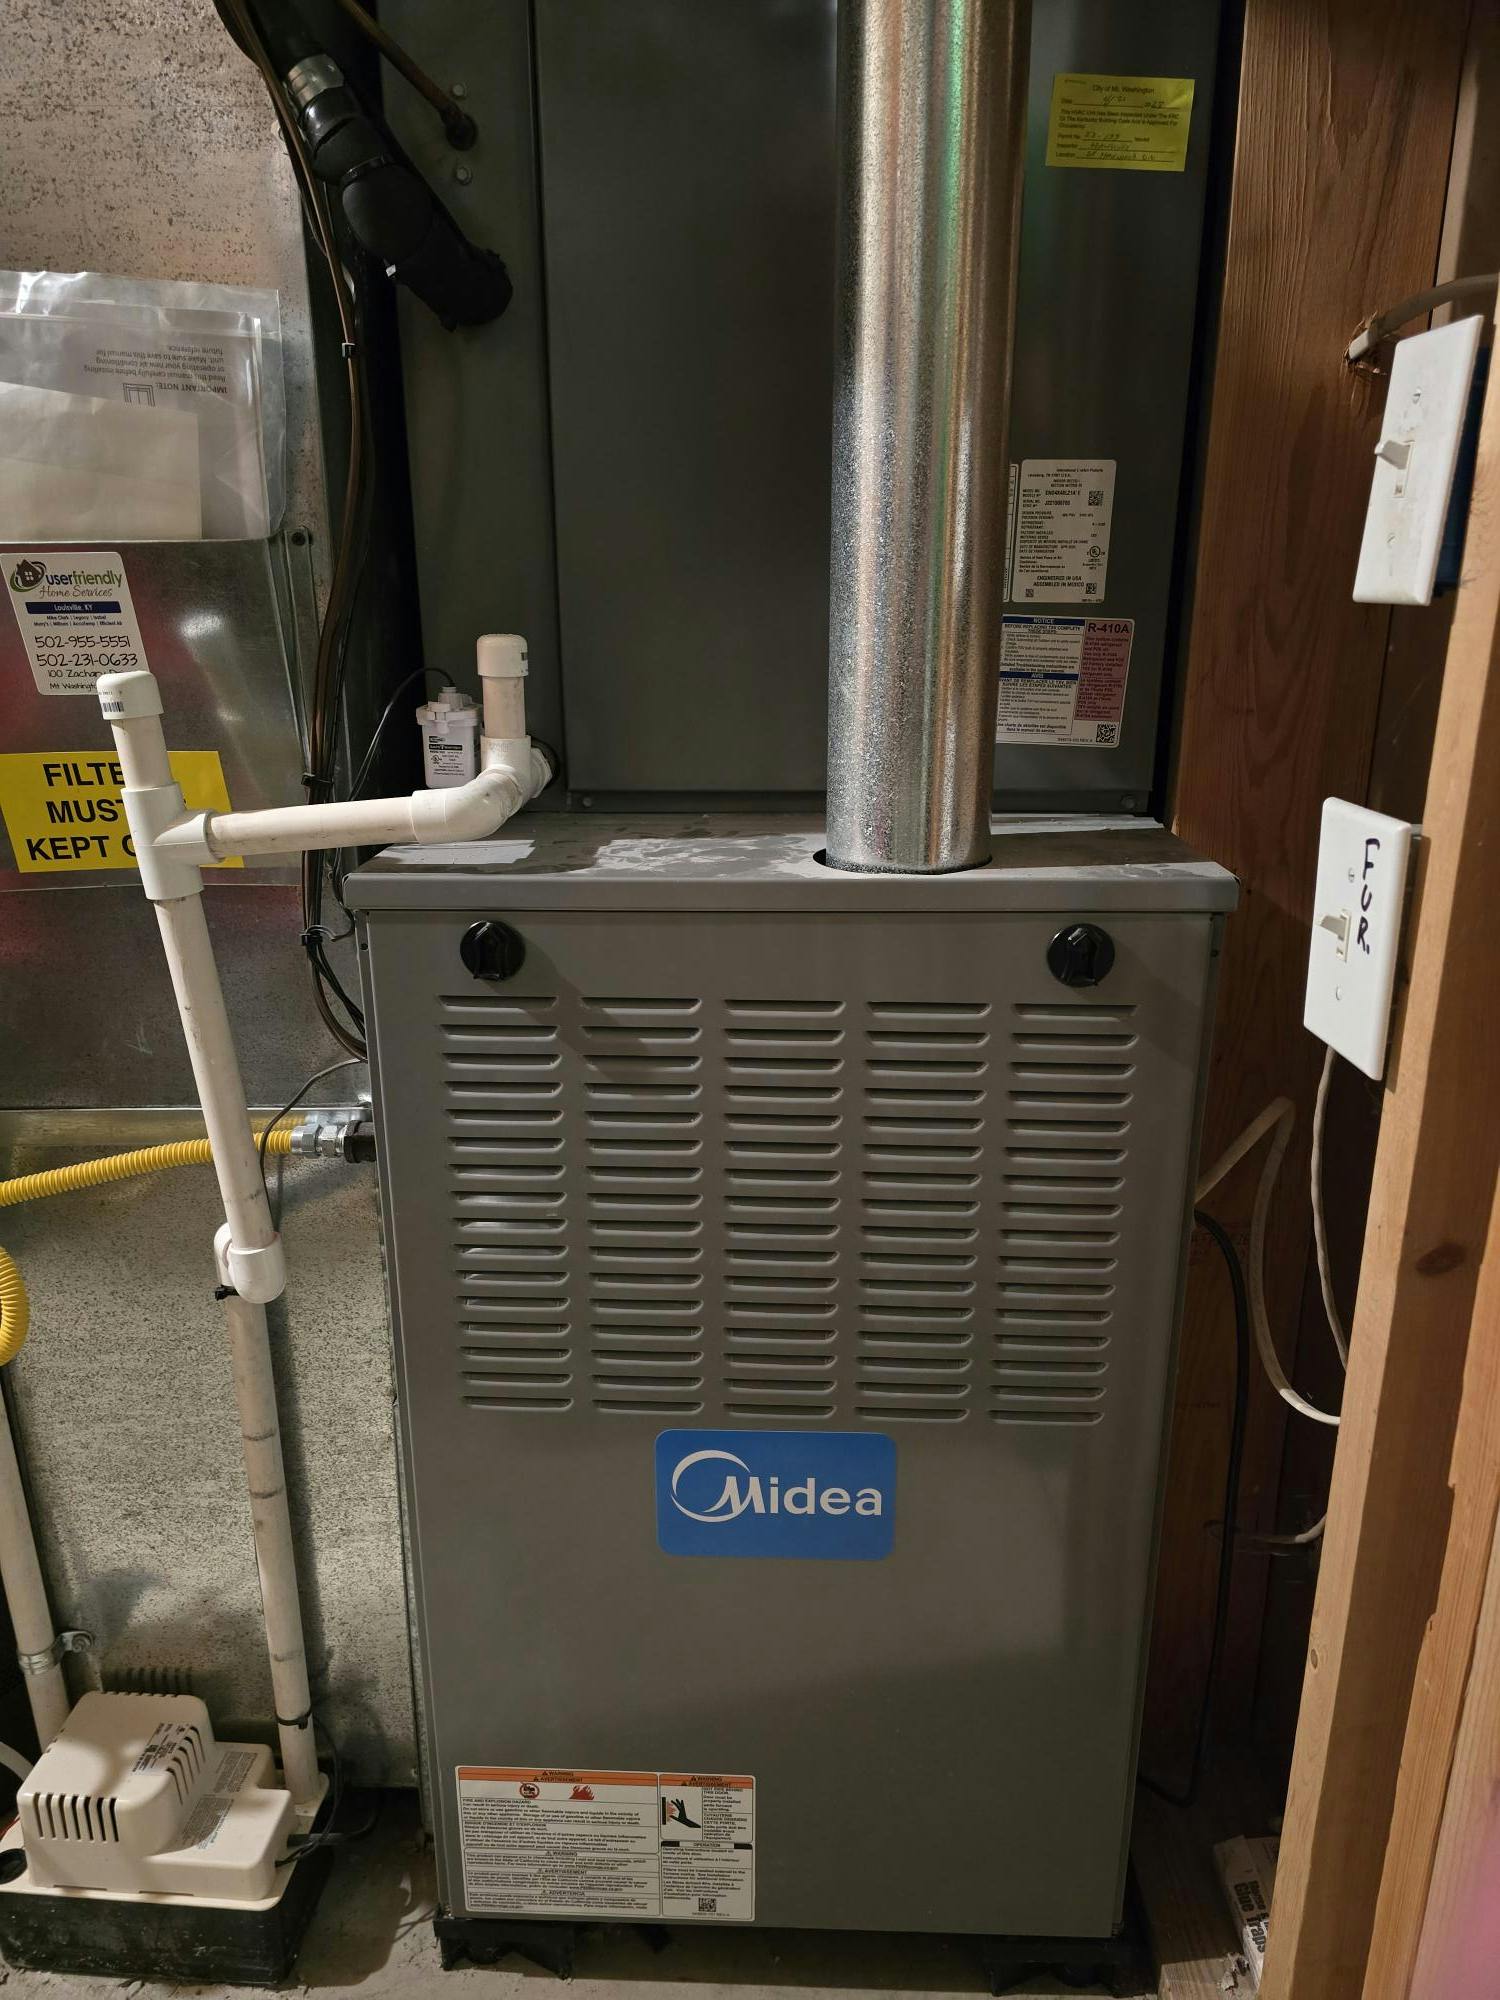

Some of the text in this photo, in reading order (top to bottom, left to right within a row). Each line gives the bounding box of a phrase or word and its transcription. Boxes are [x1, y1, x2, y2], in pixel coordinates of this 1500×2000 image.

[46, 570, 122, 587] userfriendly
[40, 585, 112, 599] Home Services
[1088, 622, 1130, 633] R-410A
[35, 635, 130, 648] 502-955-5551
[36, 653, 138, 667] 502-231-0633
[48, 669, 63, 678] 100
[43, 762, 126, 786] FILTE
[46, 799, 124, 823] MUS
[27, 836, 109, 861] KEPT
[703, 1476, 882, 1516] Midea
[1234, 1882, 1254, 1912] Glue
